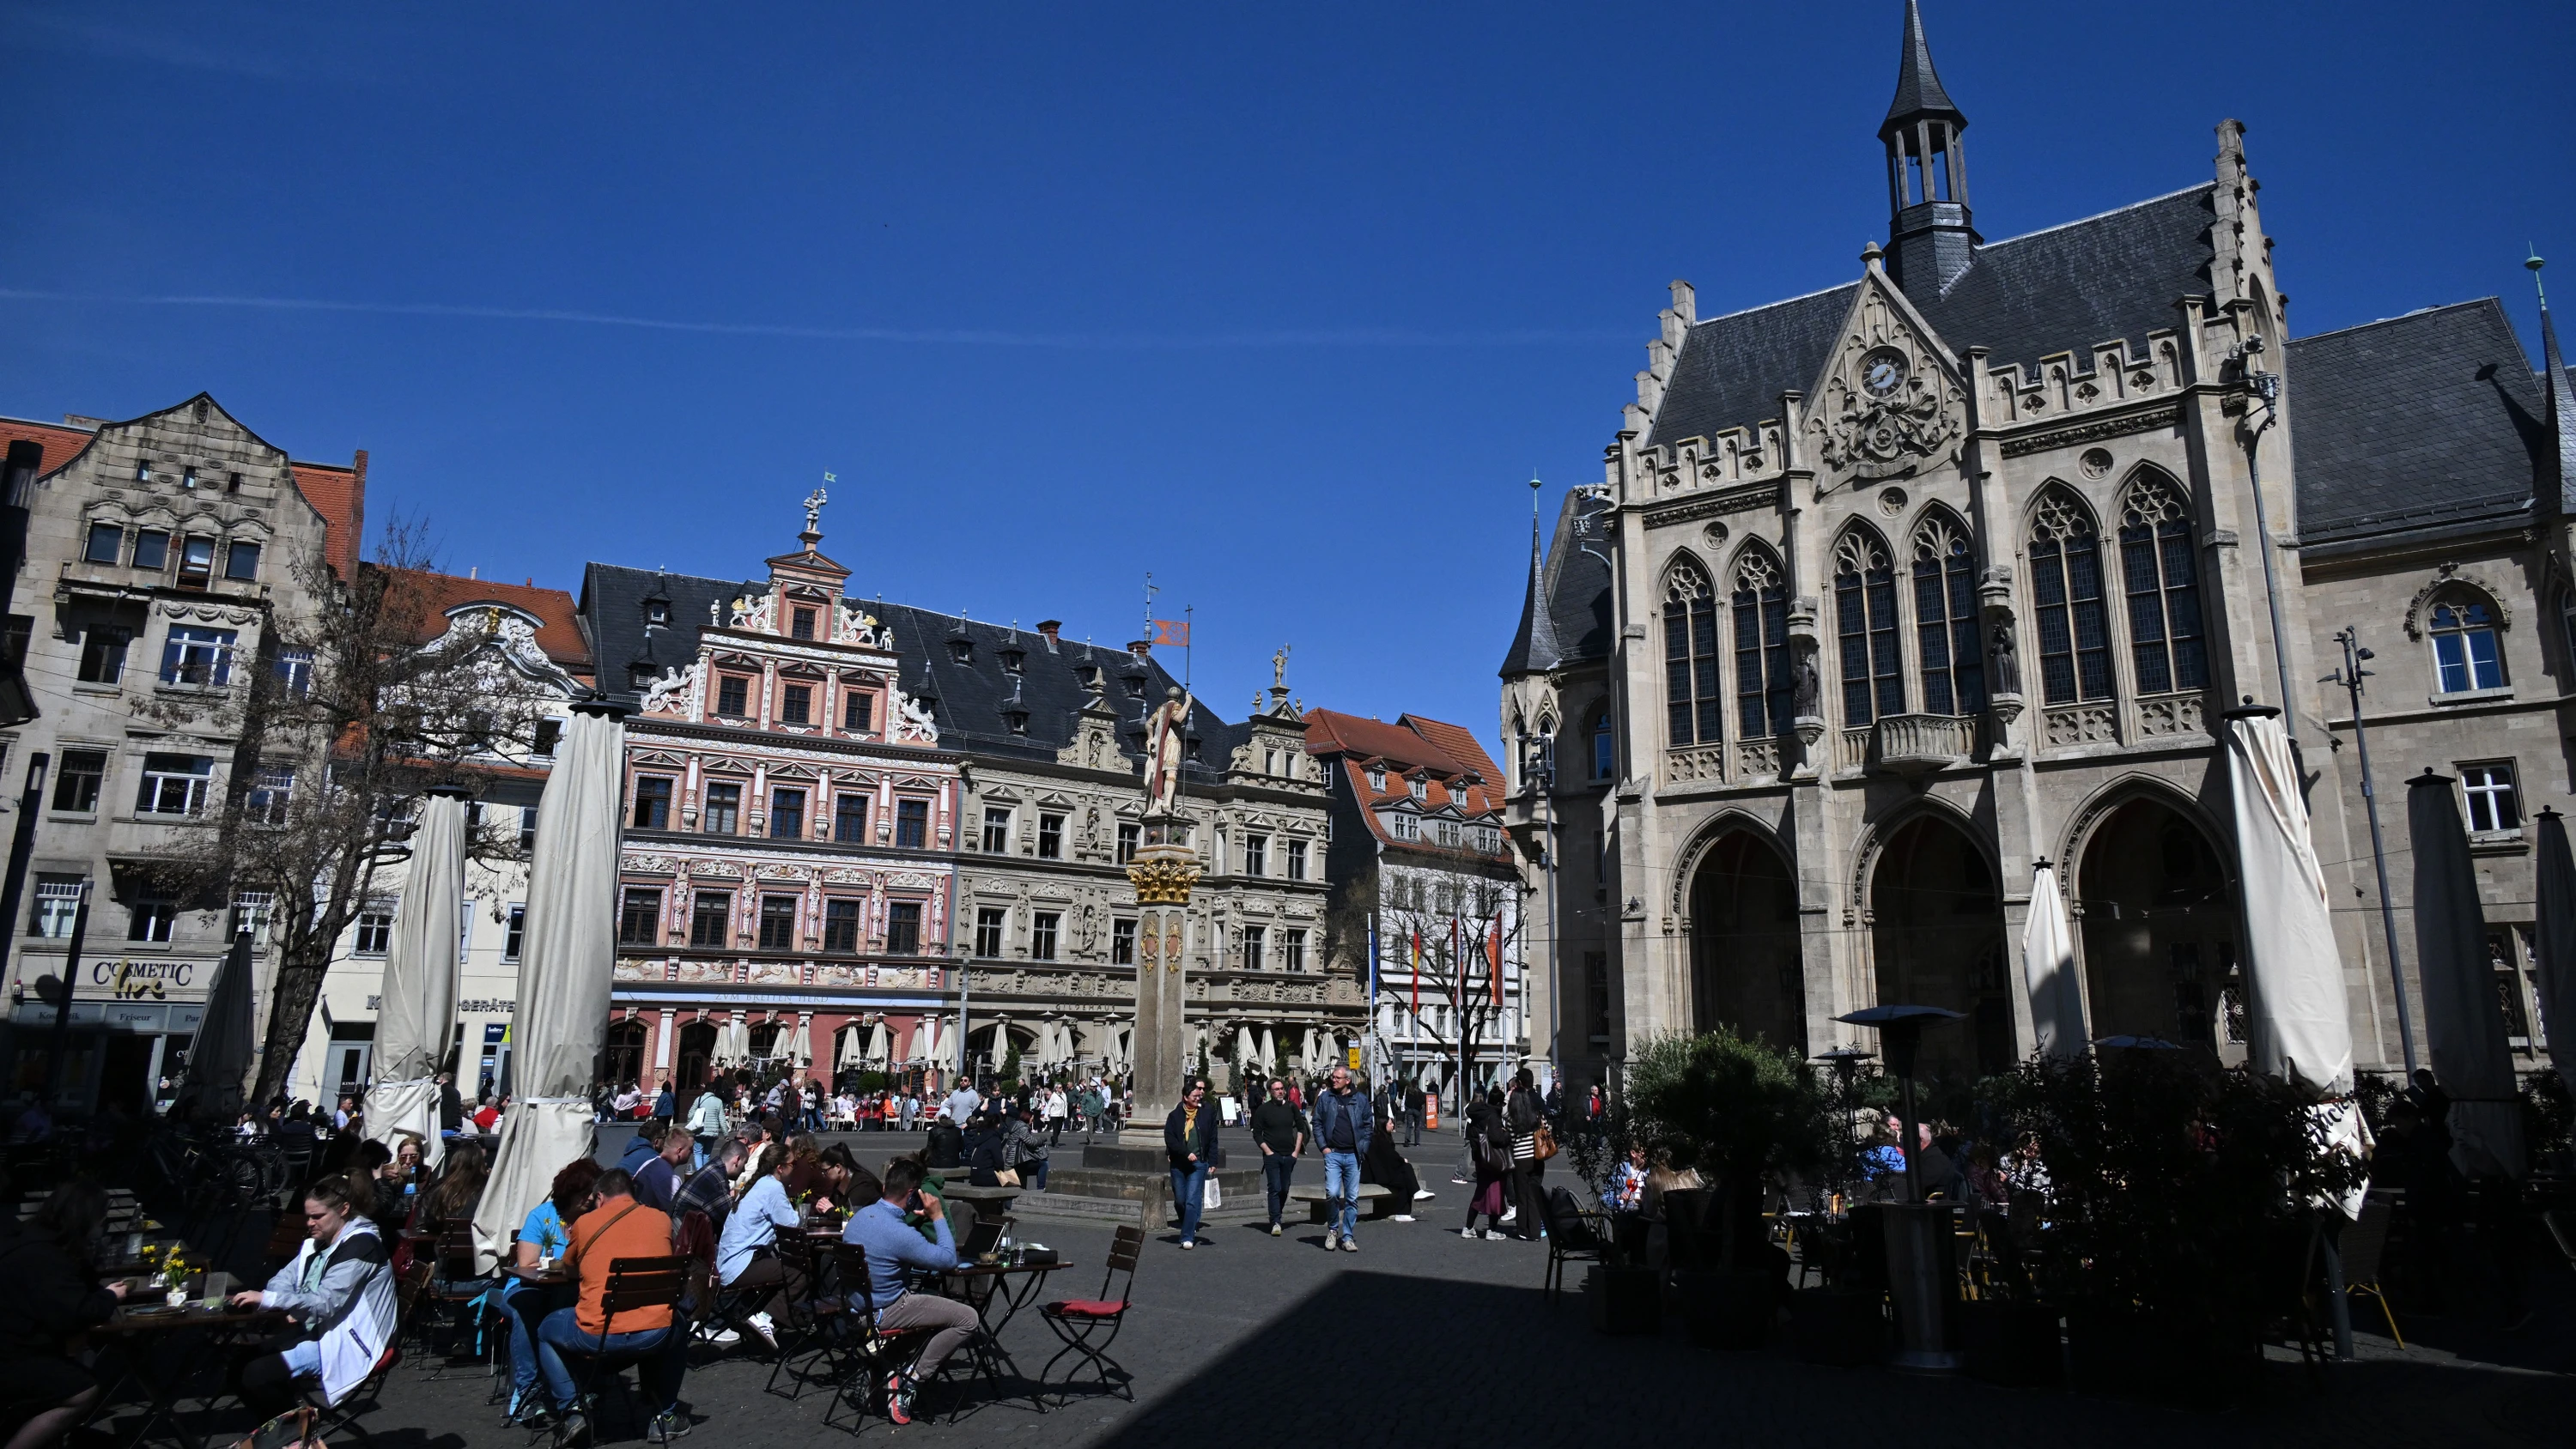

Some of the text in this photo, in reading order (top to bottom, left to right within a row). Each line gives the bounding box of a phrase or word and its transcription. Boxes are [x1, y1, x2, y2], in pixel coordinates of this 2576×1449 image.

[93, 961, 193, 987] COSMETIC
[458, 997, 516, 1012] GERÄTE
[1055, 1002, 1115, 1012] GILDEHAUS
[39, 1011, 80, 1020] Kostik
[119, 1013, 152, 1022] Friseur
